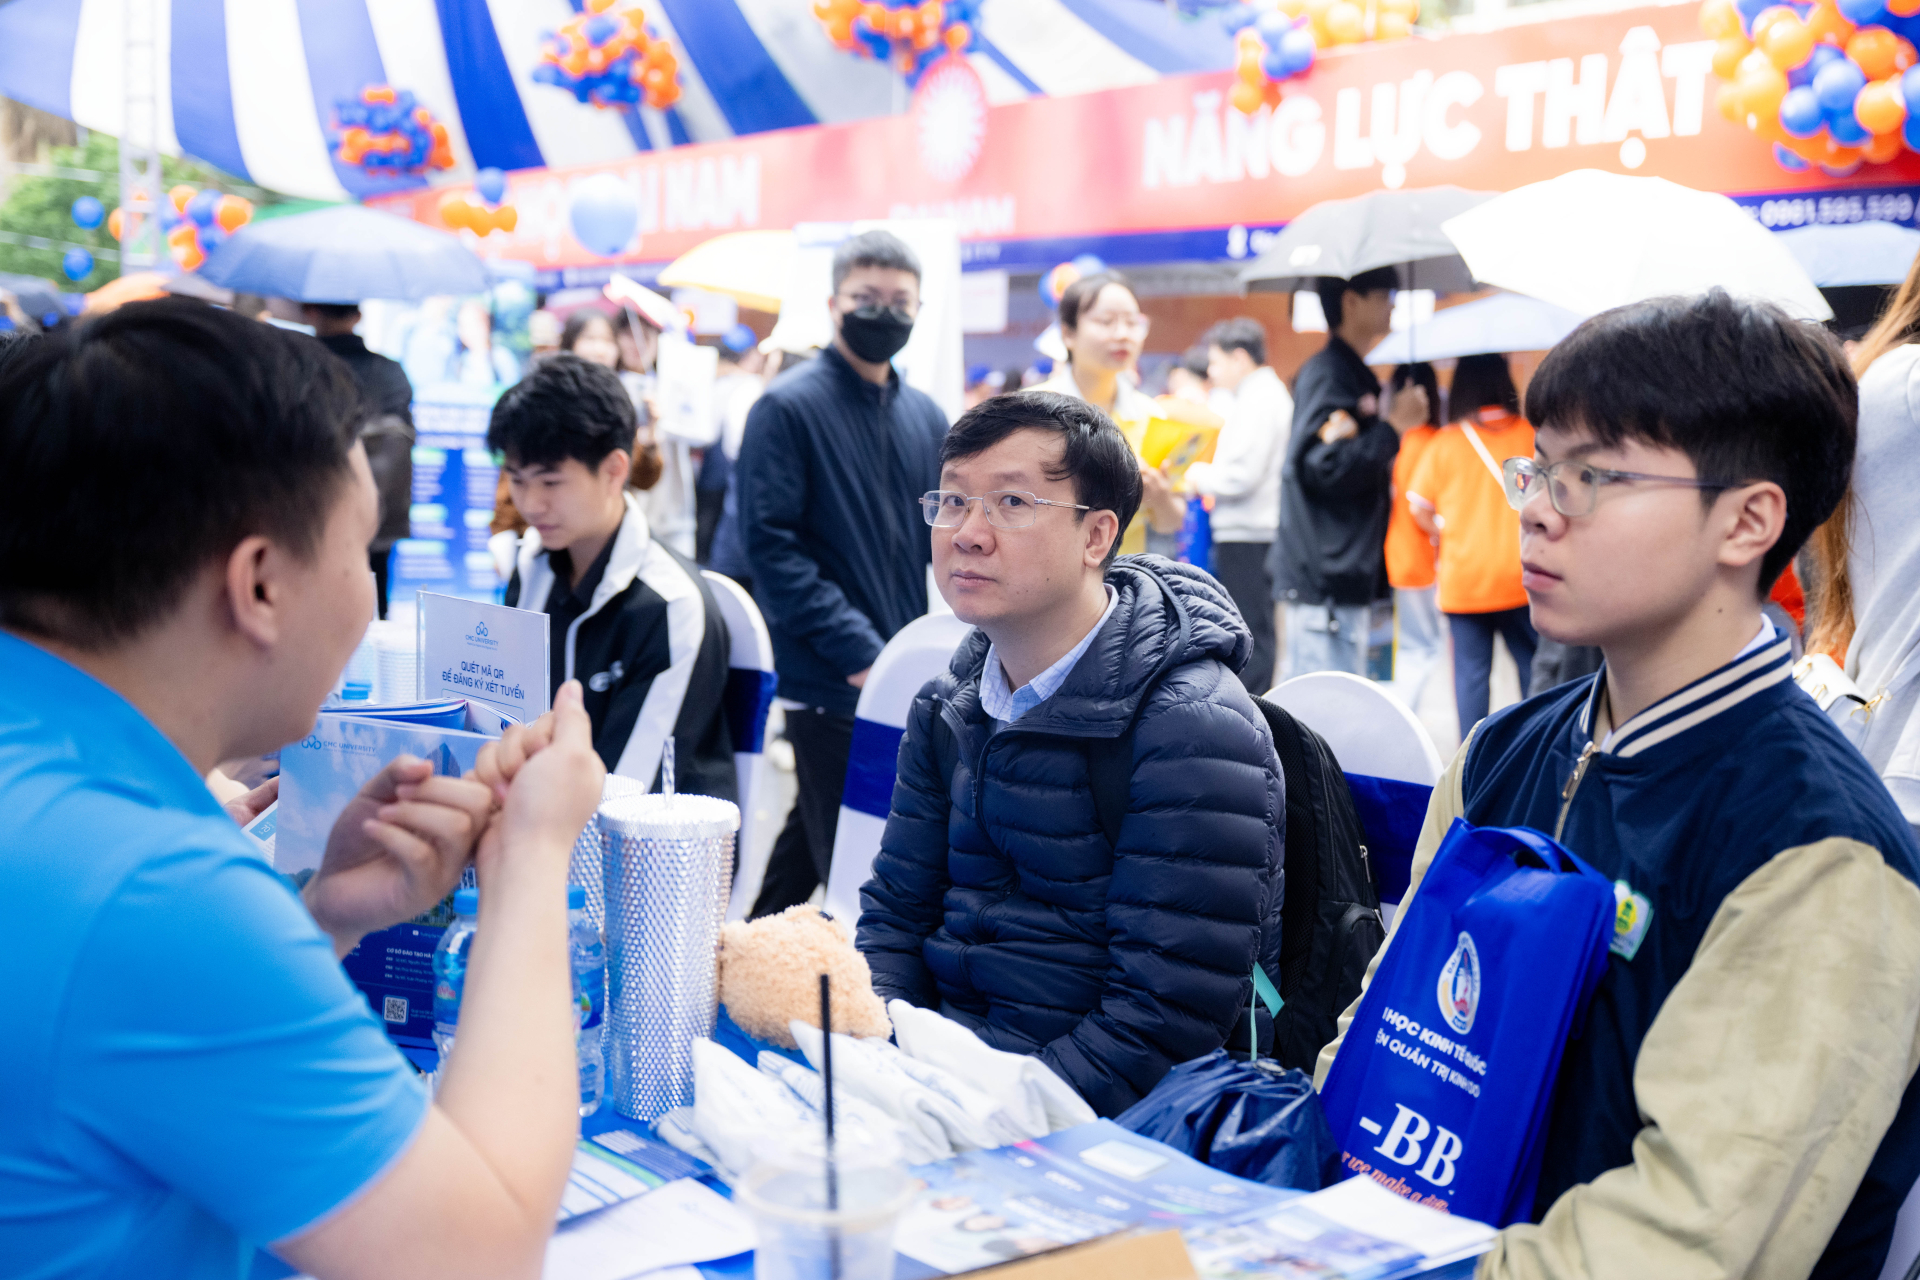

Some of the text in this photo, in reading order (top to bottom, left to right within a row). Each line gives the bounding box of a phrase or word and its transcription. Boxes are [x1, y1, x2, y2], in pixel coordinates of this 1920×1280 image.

[1142, 25, 1717, 189] NĂNG LỰC THẬT
[664, 156, 761, 230] NAM
[475, 636, 499, 646] UNIVERSITY
[442, 667, 452, 682] ĐỂ
[453, 672, 473, 688] ĐĂNG
[474, 677, 485, 690] KÝ
[501, 683, 525, 700] TUYỂN
[481, 664, 492, 676] MÃ
[493, 668, 505, 680] QR
[323, 740, 338, 748] CMC
[338, 742, 377, 753] UNIVERSITY
[1385, 1008, 1421, 1037] HỌC
[1419, 1027, 1456, 1056] KINH
[1389, 1038, 1432, 1070] QUẢN
[1431, 1060, 1451, 1083] TRỊ
[1370, 1168, 1413, 1199] make
